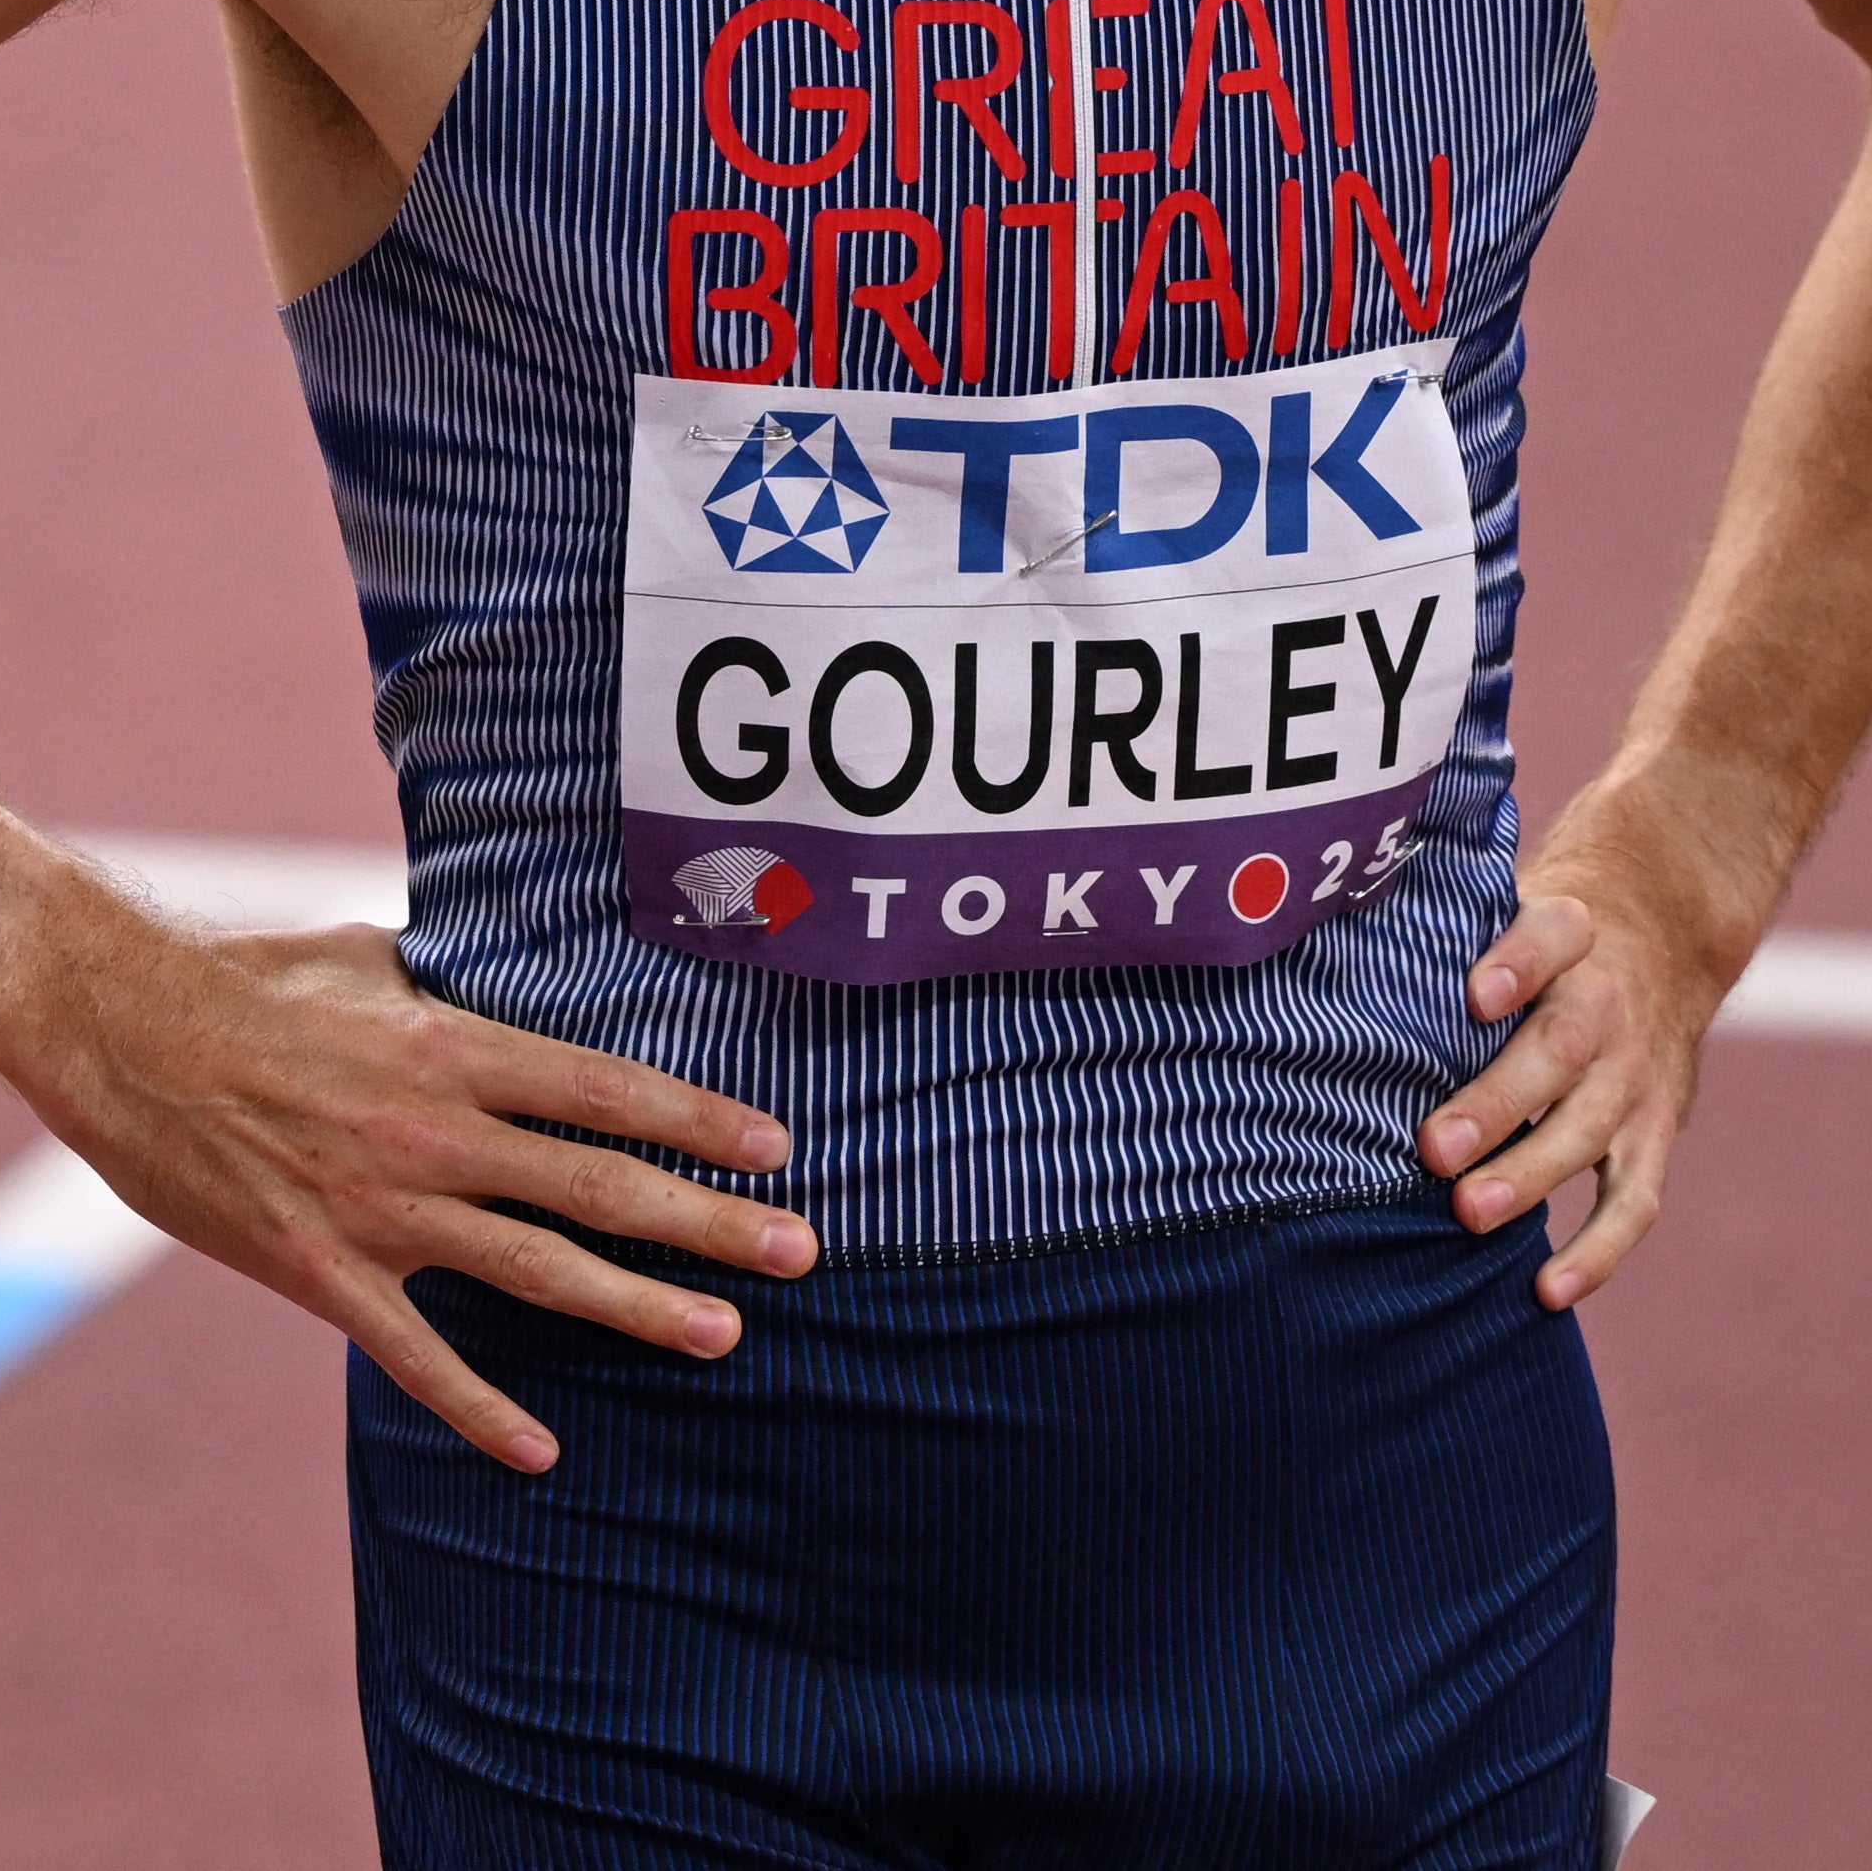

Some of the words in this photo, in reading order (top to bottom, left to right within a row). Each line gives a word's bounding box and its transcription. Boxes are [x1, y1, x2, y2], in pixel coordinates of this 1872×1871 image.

[668, 154, 1450, 387] BRITAIN
[890, 369, 1422, 575] TDK
[675, 594, 1440, 817] GOURLEY
[852, 852, 1290, 939] TOKYO
[1311, 816, 1406, 902] 25
